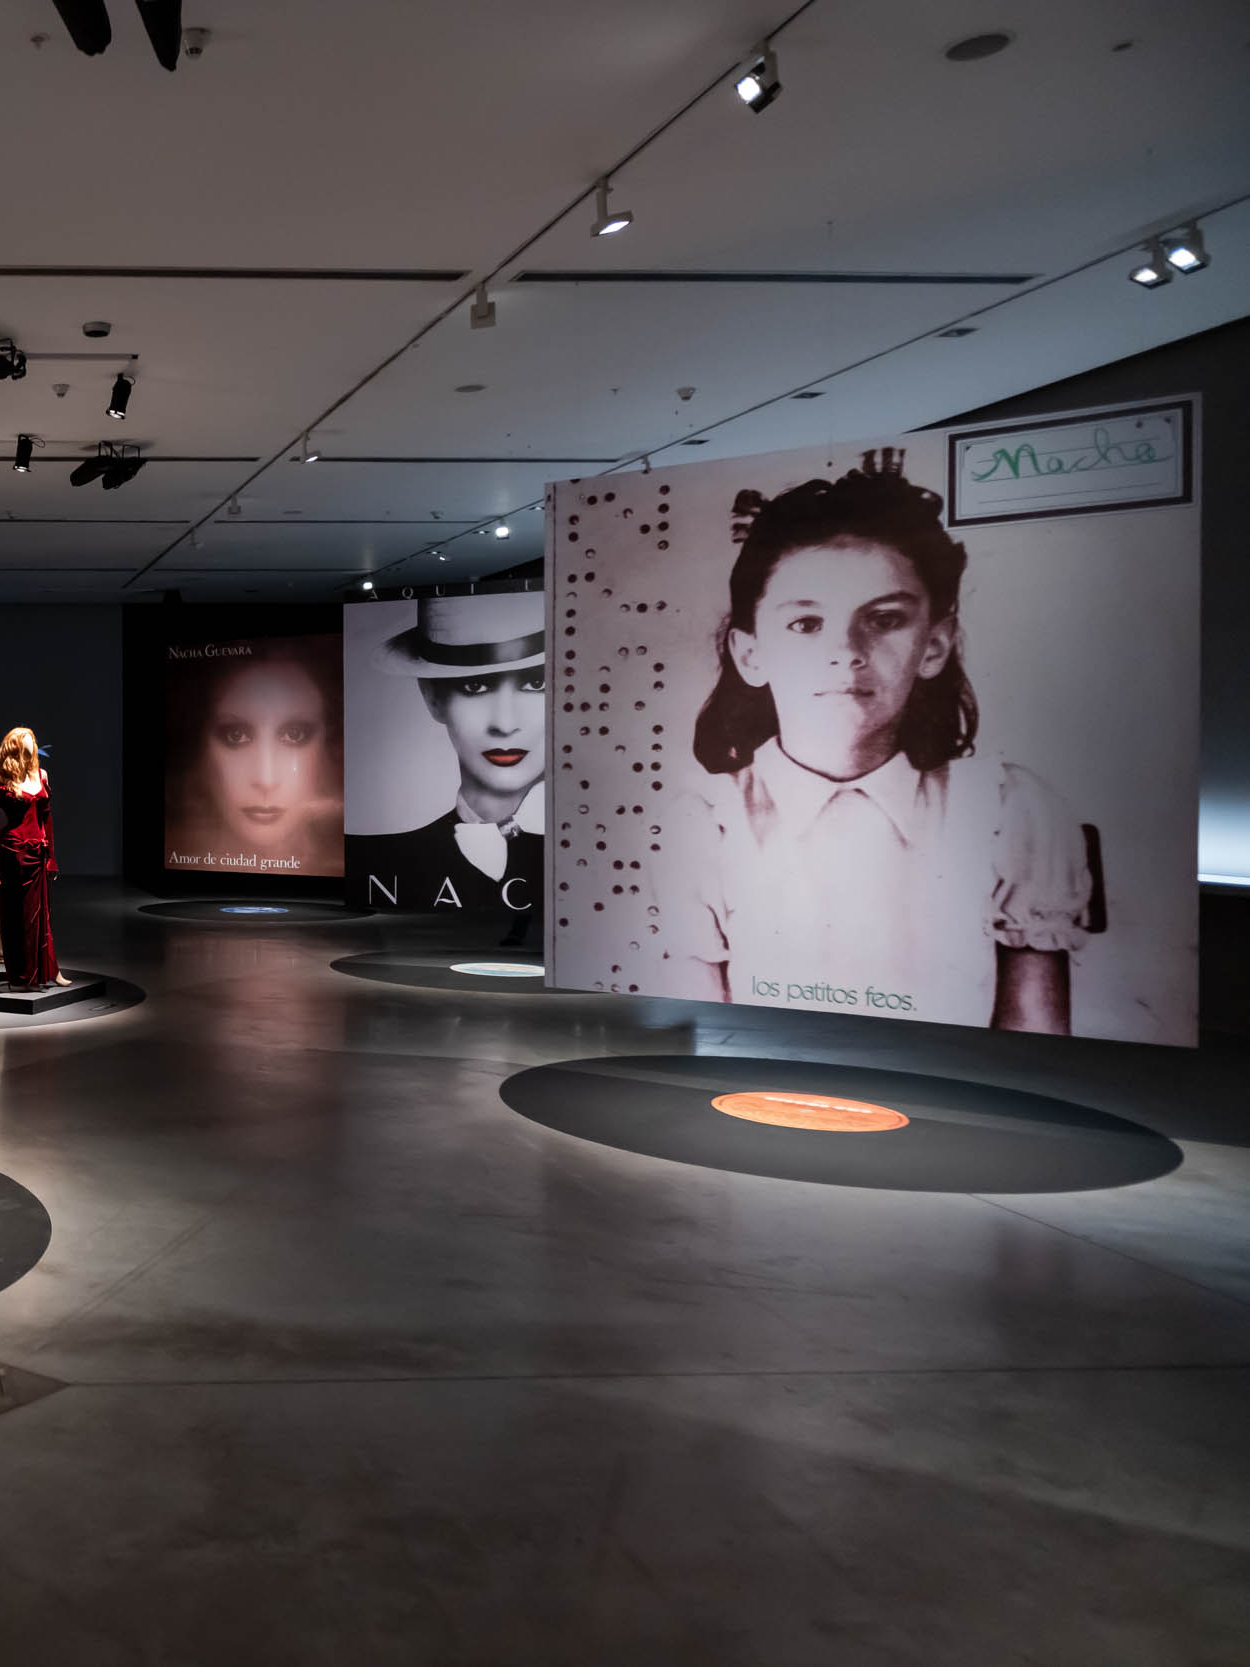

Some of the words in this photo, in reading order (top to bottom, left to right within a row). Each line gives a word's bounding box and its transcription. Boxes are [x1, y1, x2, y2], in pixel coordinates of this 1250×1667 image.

[971, 427, 1174, 481] Nacha
[168, 851, 201, 865] Amor
[203, 852, 216, 865] de
[220, 853, 257, 867] ciudad
[260, 856, 301, 870] grande
[752, 975, 780, 998] los
[787, 981, 858, 1005] patitos
[865, 986, 917, 1012] feos.
